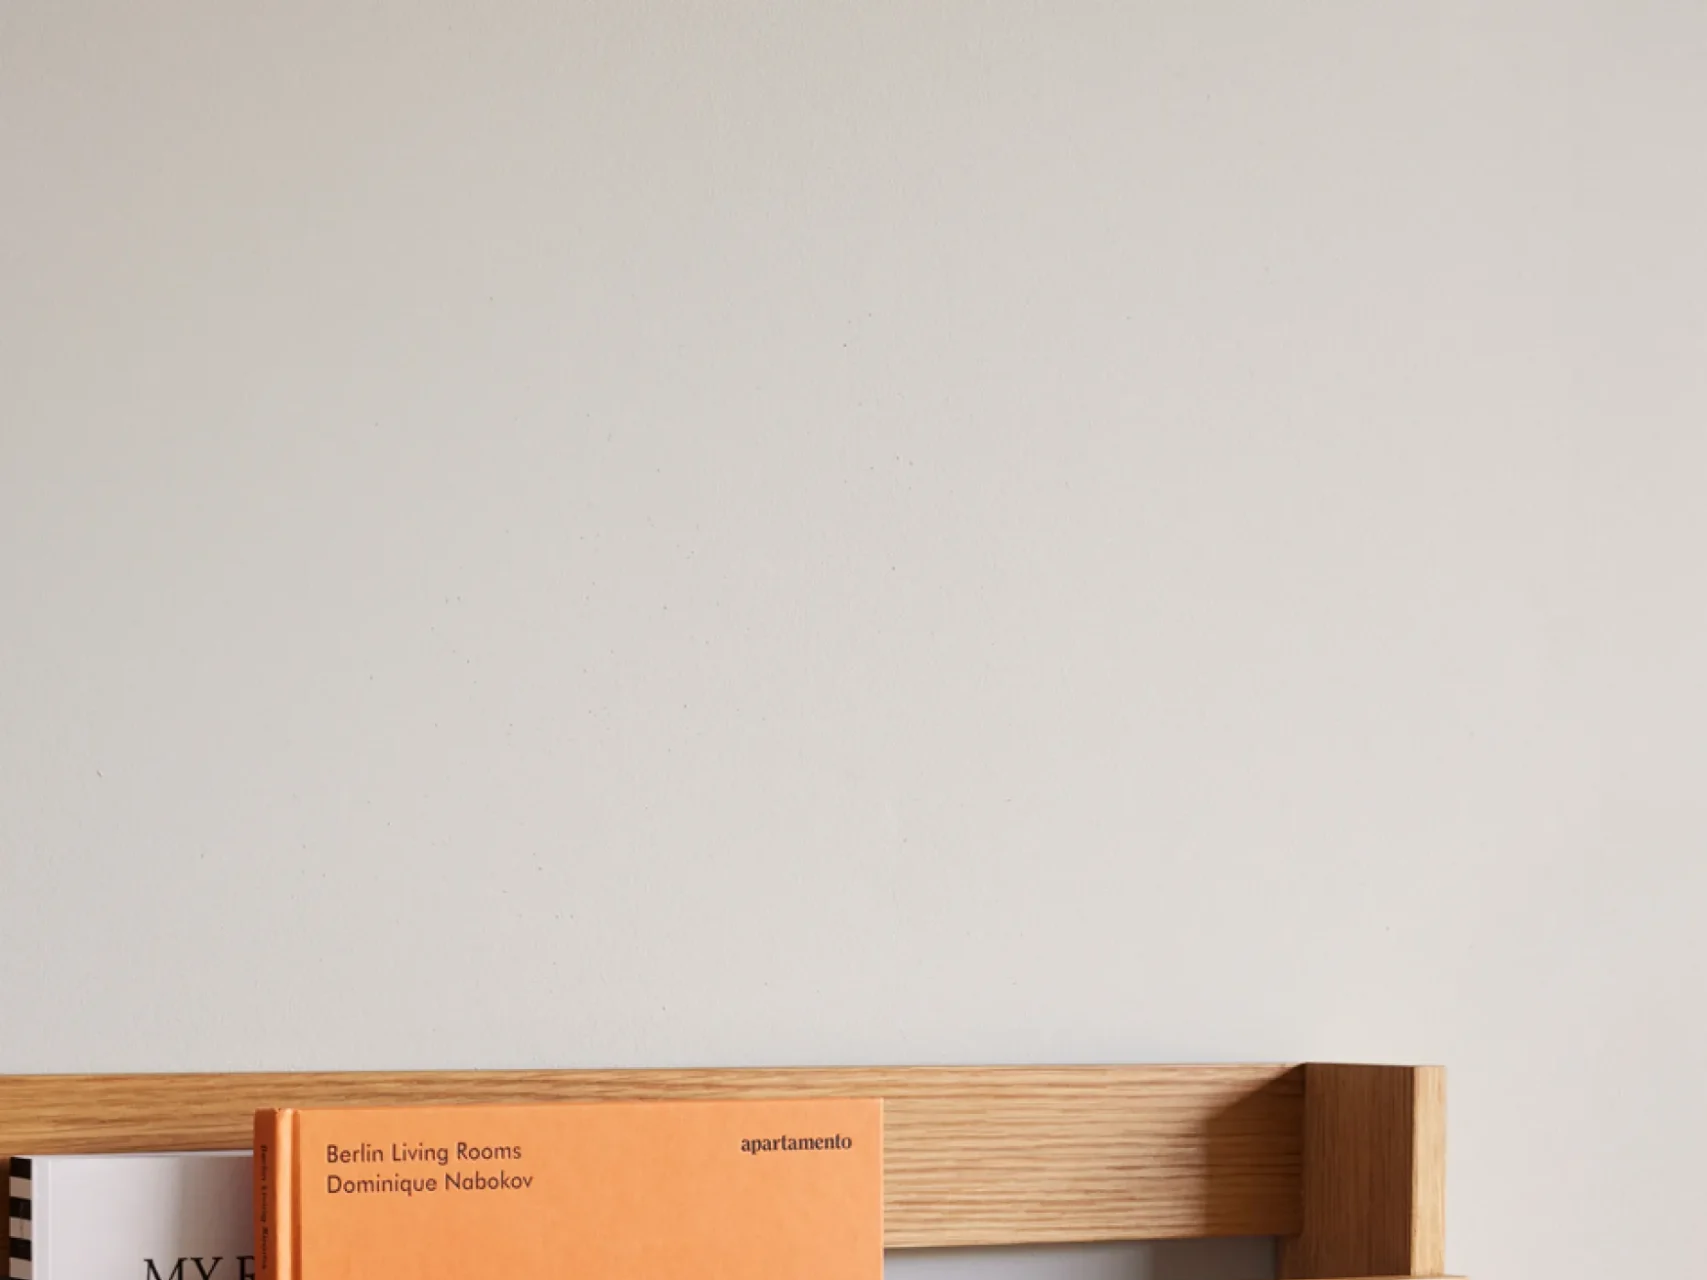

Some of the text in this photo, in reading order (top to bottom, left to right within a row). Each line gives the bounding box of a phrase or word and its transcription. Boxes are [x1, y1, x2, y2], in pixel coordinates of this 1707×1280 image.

[326, 1141, 522, 1166] Berlin Living Rooms
[741, 1133, 853, 1156] apartamento
[326, 1170, 534, 1197] Dominique Nabokov
